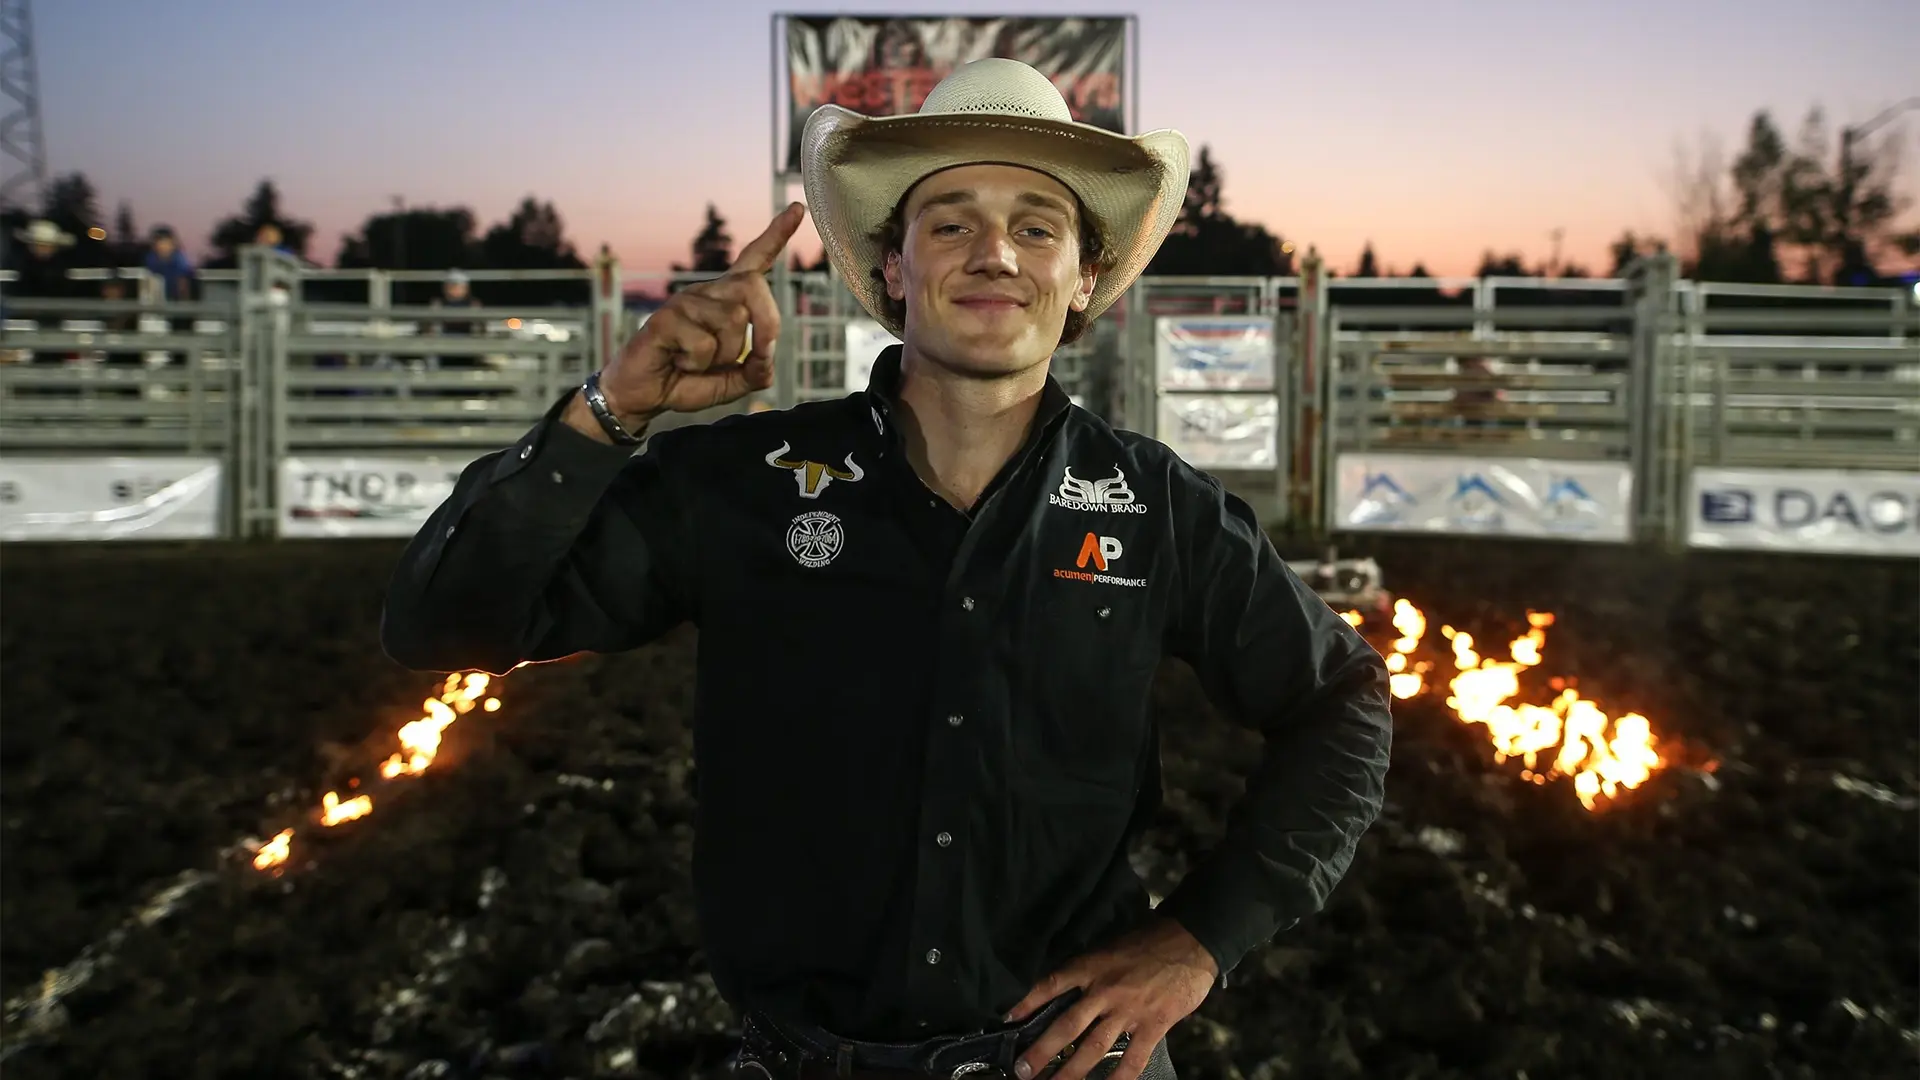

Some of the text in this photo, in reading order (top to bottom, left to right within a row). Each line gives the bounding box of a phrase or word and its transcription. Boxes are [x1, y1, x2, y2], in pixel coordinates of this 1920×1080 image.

[1049, 493, 1148, 514] BAREDOWN BRAND
[1774, 488, 1920, 533] DAC
[791, 510, 841, 525] INDEPENDENT
[1076, 532, 1123, 571] AP
[798, 557, 831, 568] WELDING
